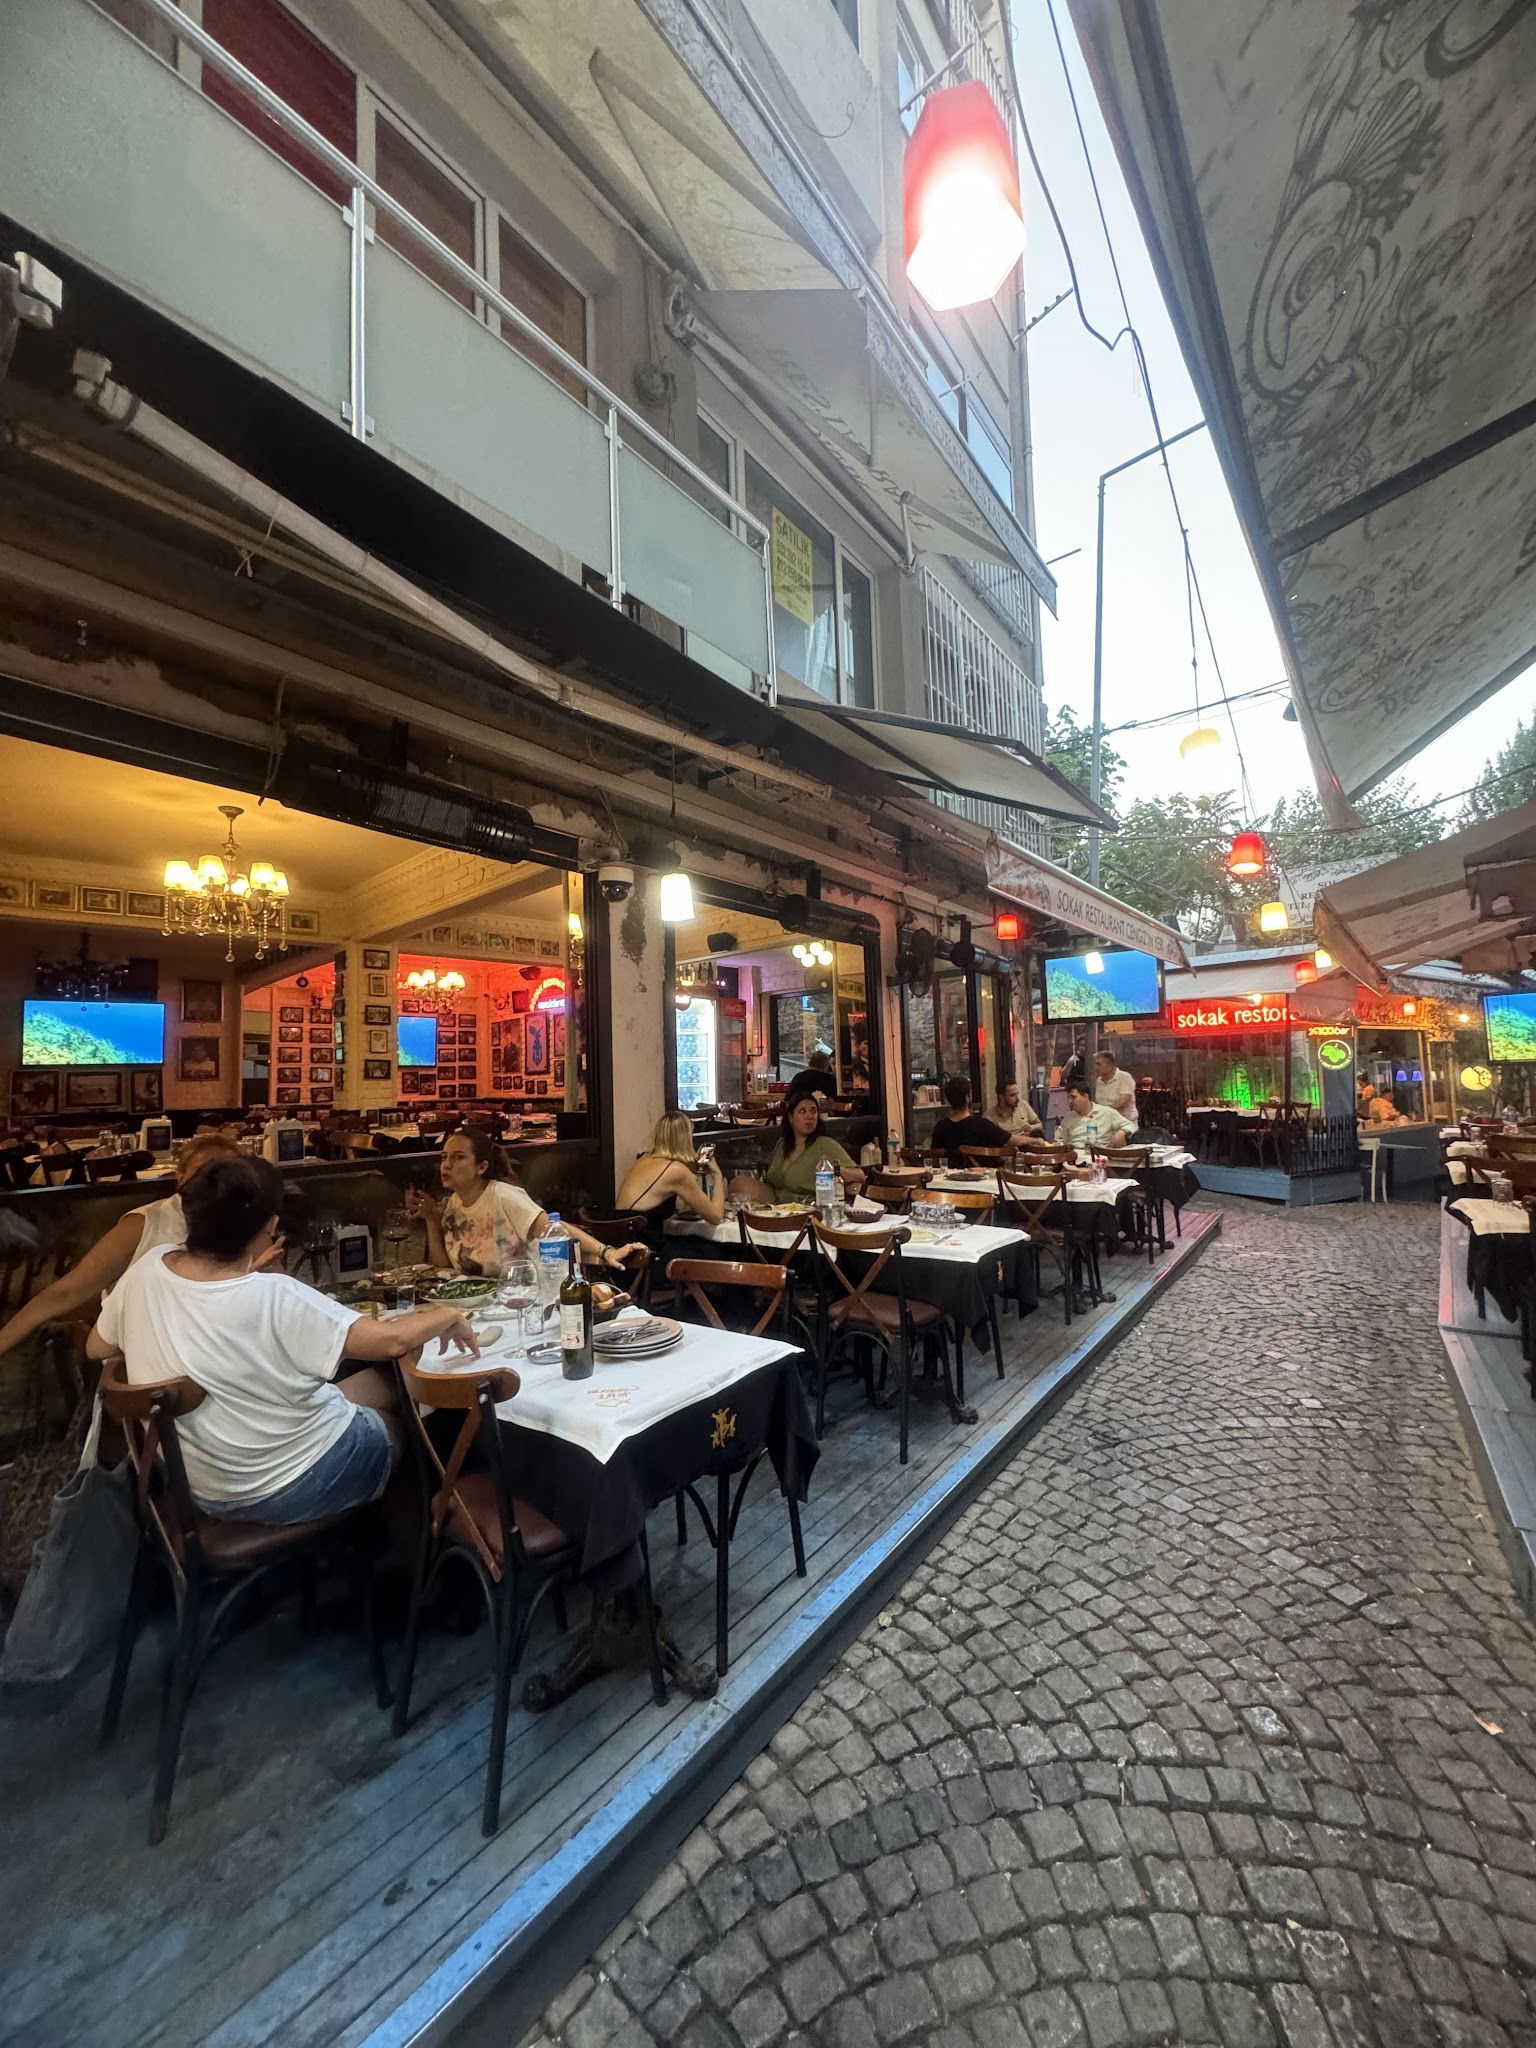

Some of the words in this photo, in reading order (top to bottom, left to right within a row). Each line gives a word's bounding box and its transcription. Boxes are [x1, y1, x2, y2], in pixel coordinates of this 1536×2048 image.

[1057, 889, 1084, 920] SOKAK
[1085, 904, 1125, 936] RESTAURANT
[1177, 1006, 1228, 1028] sokak
